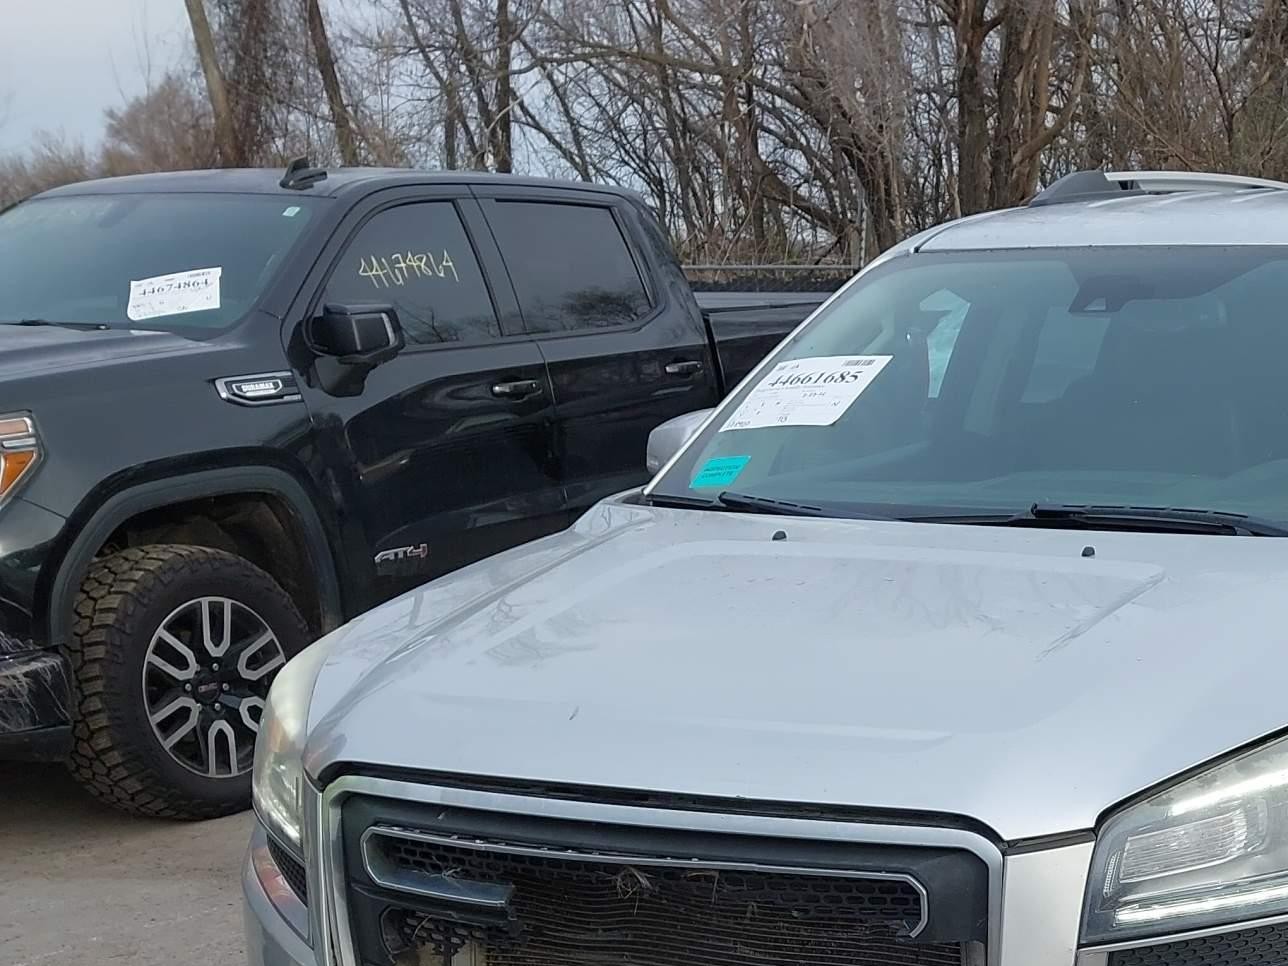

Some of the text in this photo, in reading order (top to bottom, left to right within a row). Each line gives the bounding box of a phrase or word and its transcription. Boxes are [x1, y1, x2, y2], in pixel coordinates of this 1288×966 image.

[358, 249, 459, 289] 44674864
[139, 278, 209, 297] 44674864
[769, 370, 863, 387] 44661685
[374, 543, 428, 564] AT4
